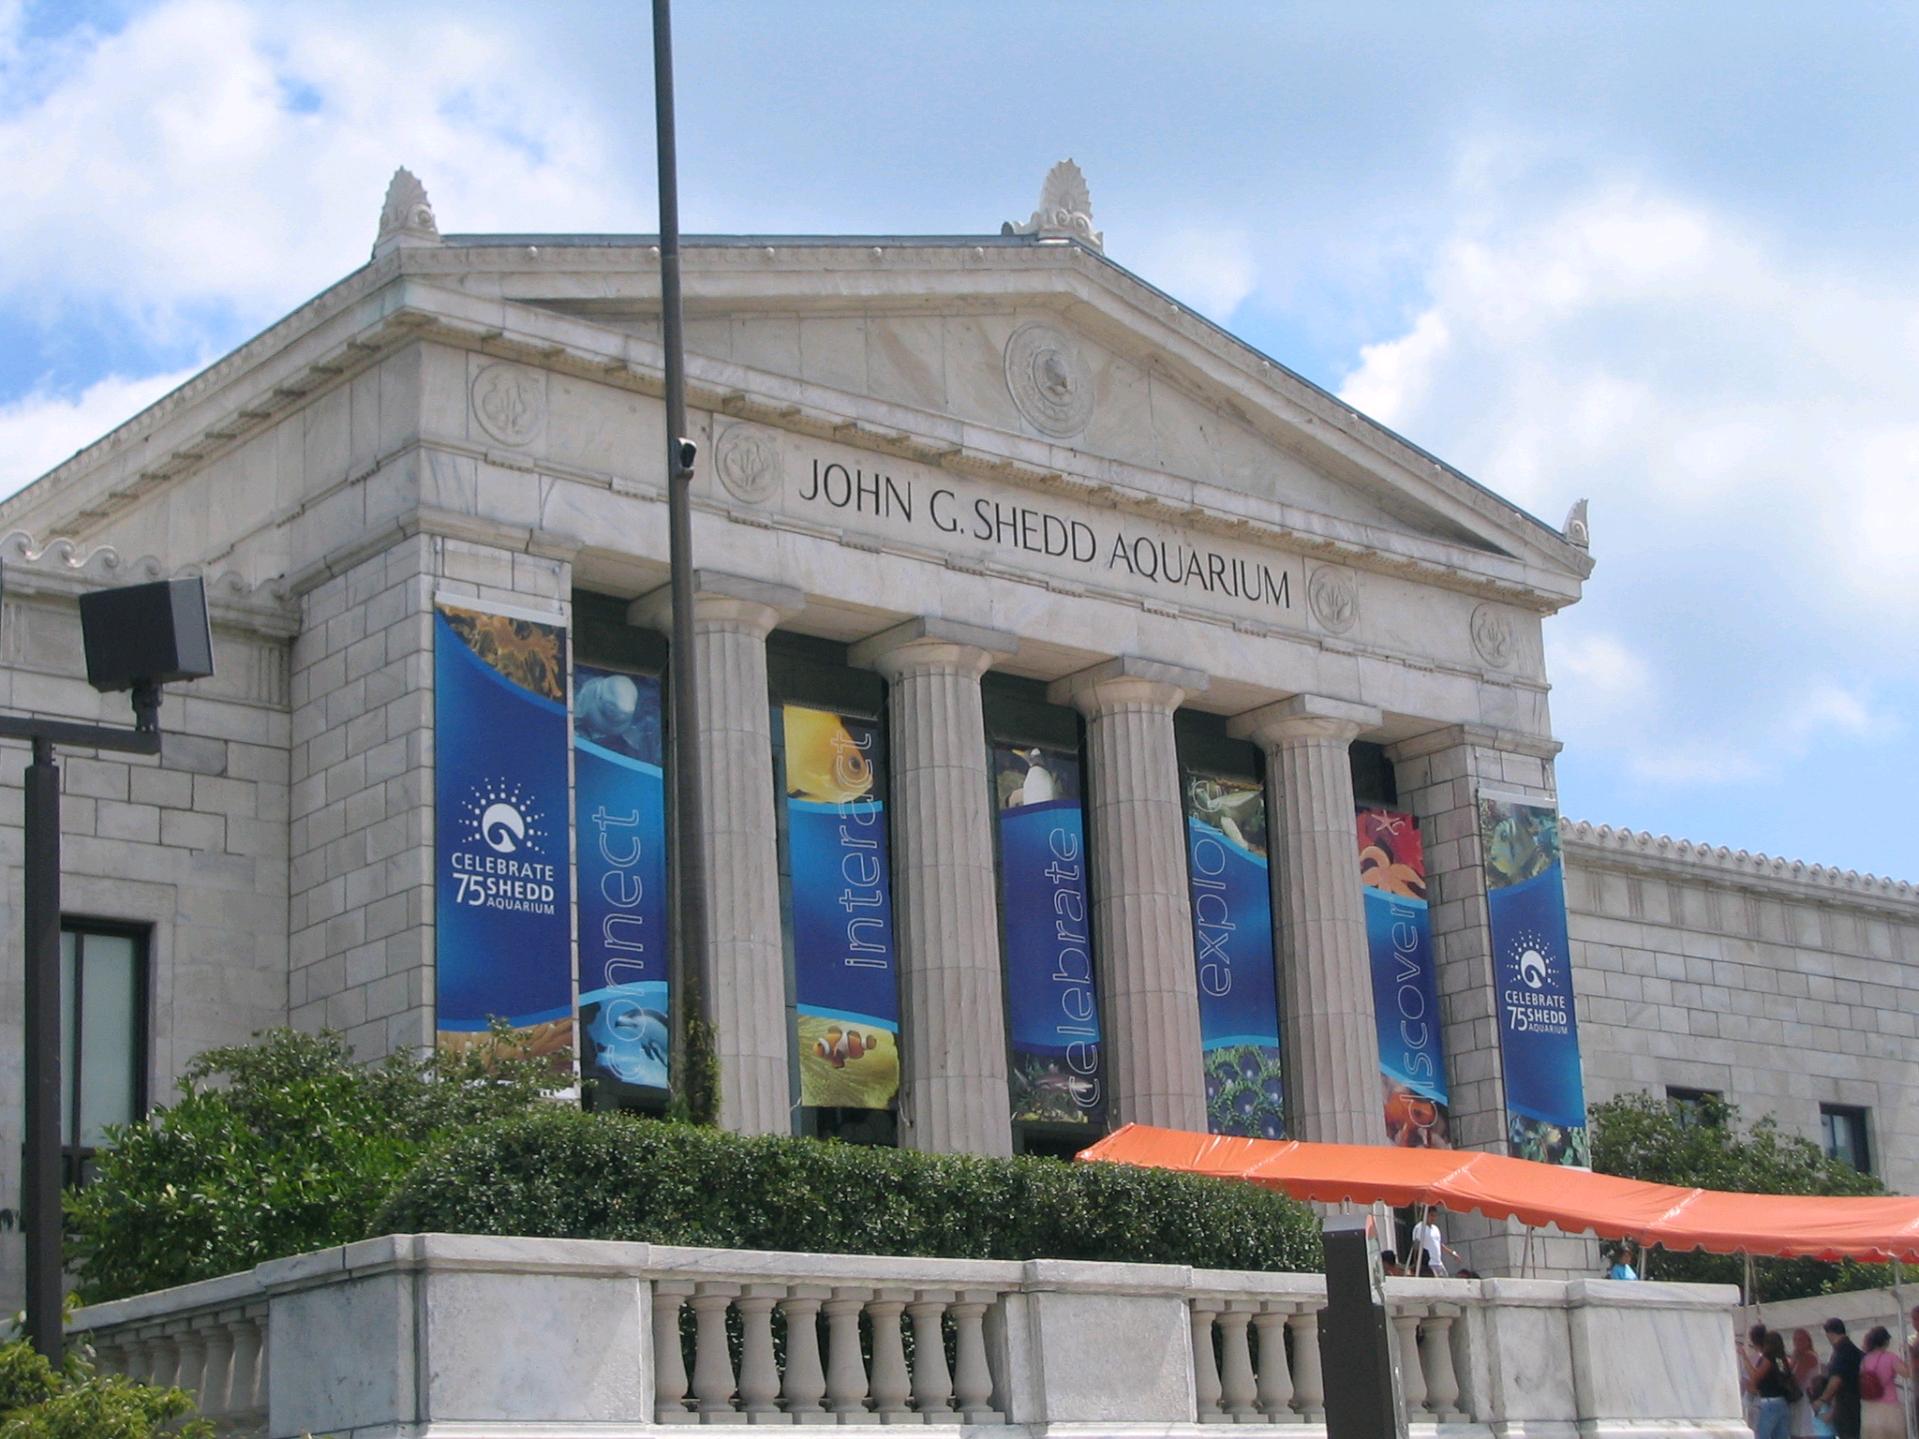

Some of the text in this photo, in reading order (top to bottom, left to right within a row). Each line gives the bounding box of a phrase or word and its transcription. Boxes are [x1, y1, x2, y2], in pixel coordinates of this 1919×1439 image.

[799, 458, 1292, 609] JOHN G. SHEDD AQUARIUM
[451, 851, 555, 882] CELEBRATE
[452, 872, 555, 906] 75 SHEDD
[830, 732, 888, 969] interact
[1192, 778, 1236, 997] explore
[486, 897, 555, 915] AQUARIUM
[592, 805, 644, 1080] connect
[1045, 827, 1101, 1108] celebrate
[1505, 990, 1566, 1009] CELEBRATE
[1390, 901, 1438, 1129] discover
[1507, 1006, 1567, 1031] 75 SHEDD
[1528, 1023, 1568, 1034] AQUARIUM
